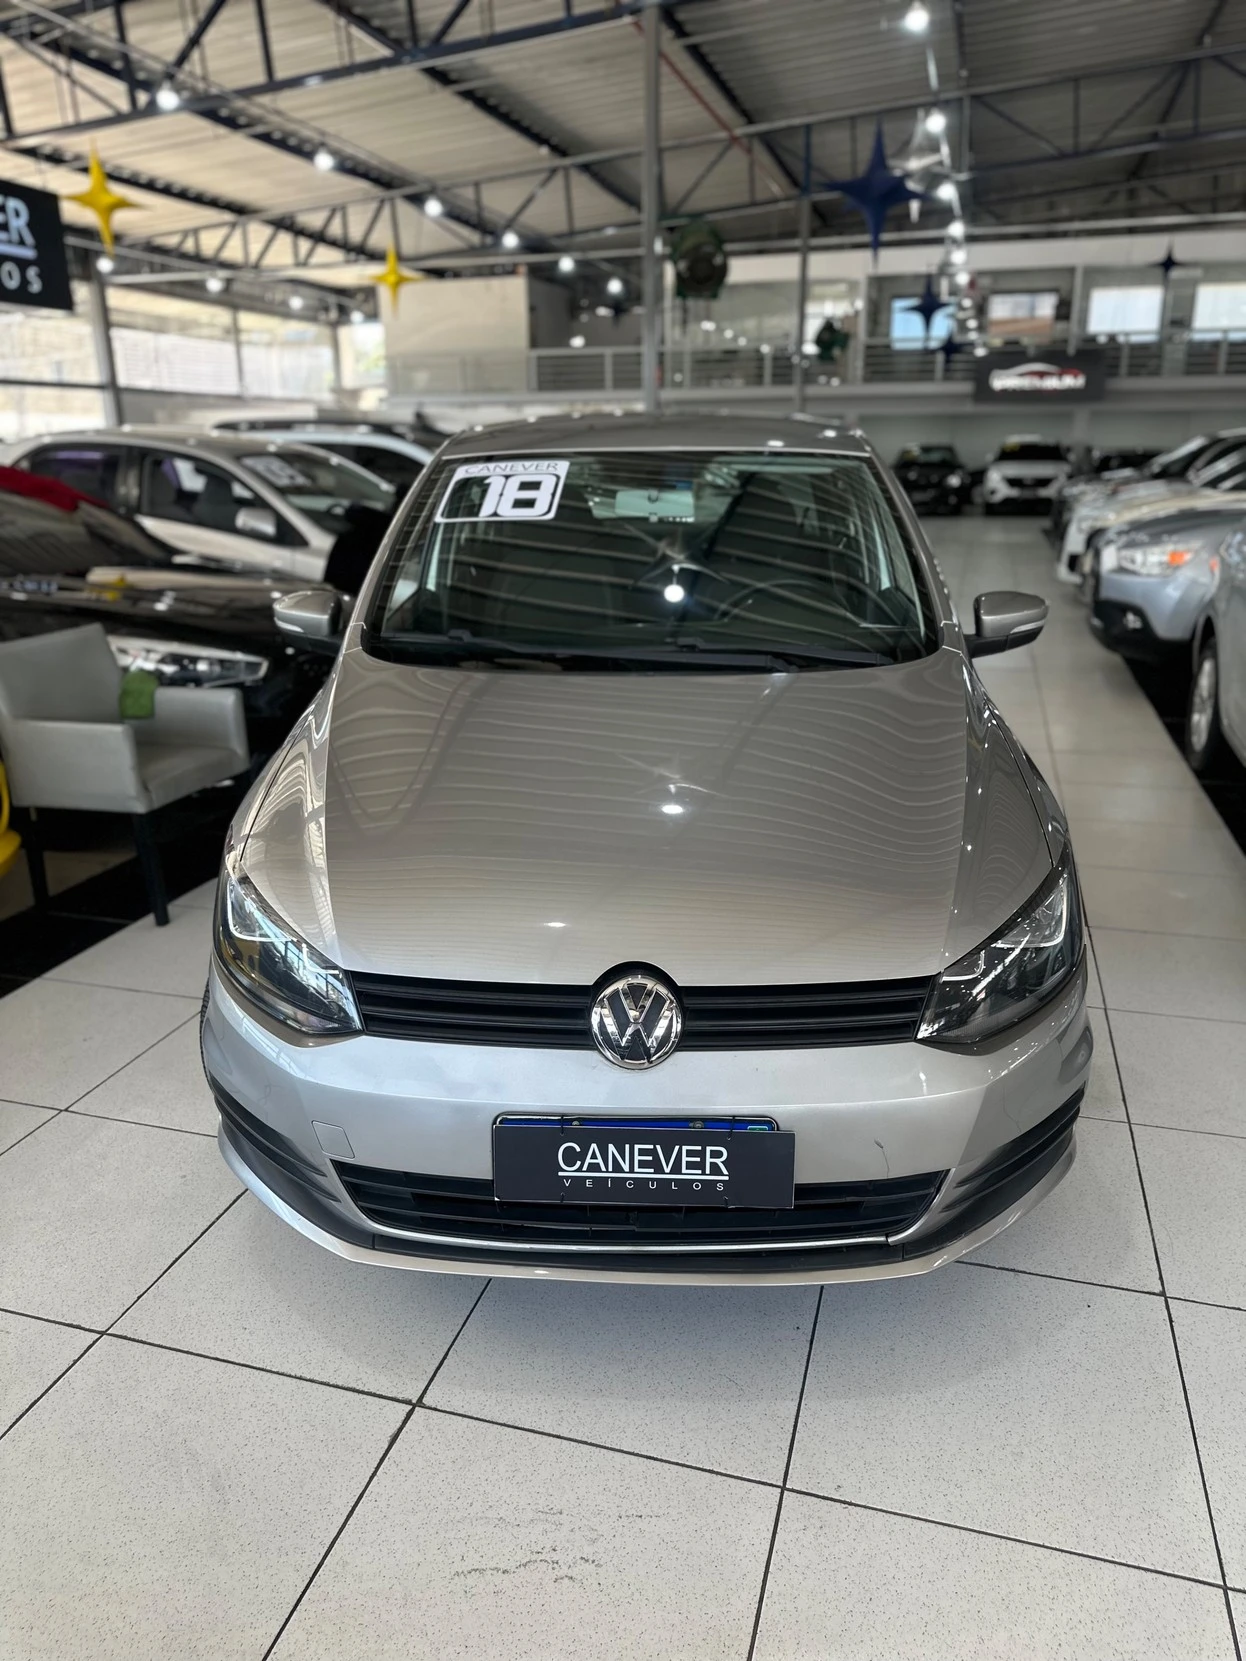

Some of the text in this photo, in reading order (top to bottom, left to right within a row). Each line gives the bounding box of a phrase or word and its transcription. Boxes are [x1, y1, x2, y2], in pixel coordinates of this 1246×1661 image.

[465, 462, 558, 475] CANEVER
[479, 474, 557, 517] 18
[557, 1142, 729, 1175] CANEVER
[563, 1178, 724, 1191] VEÍCULOS
